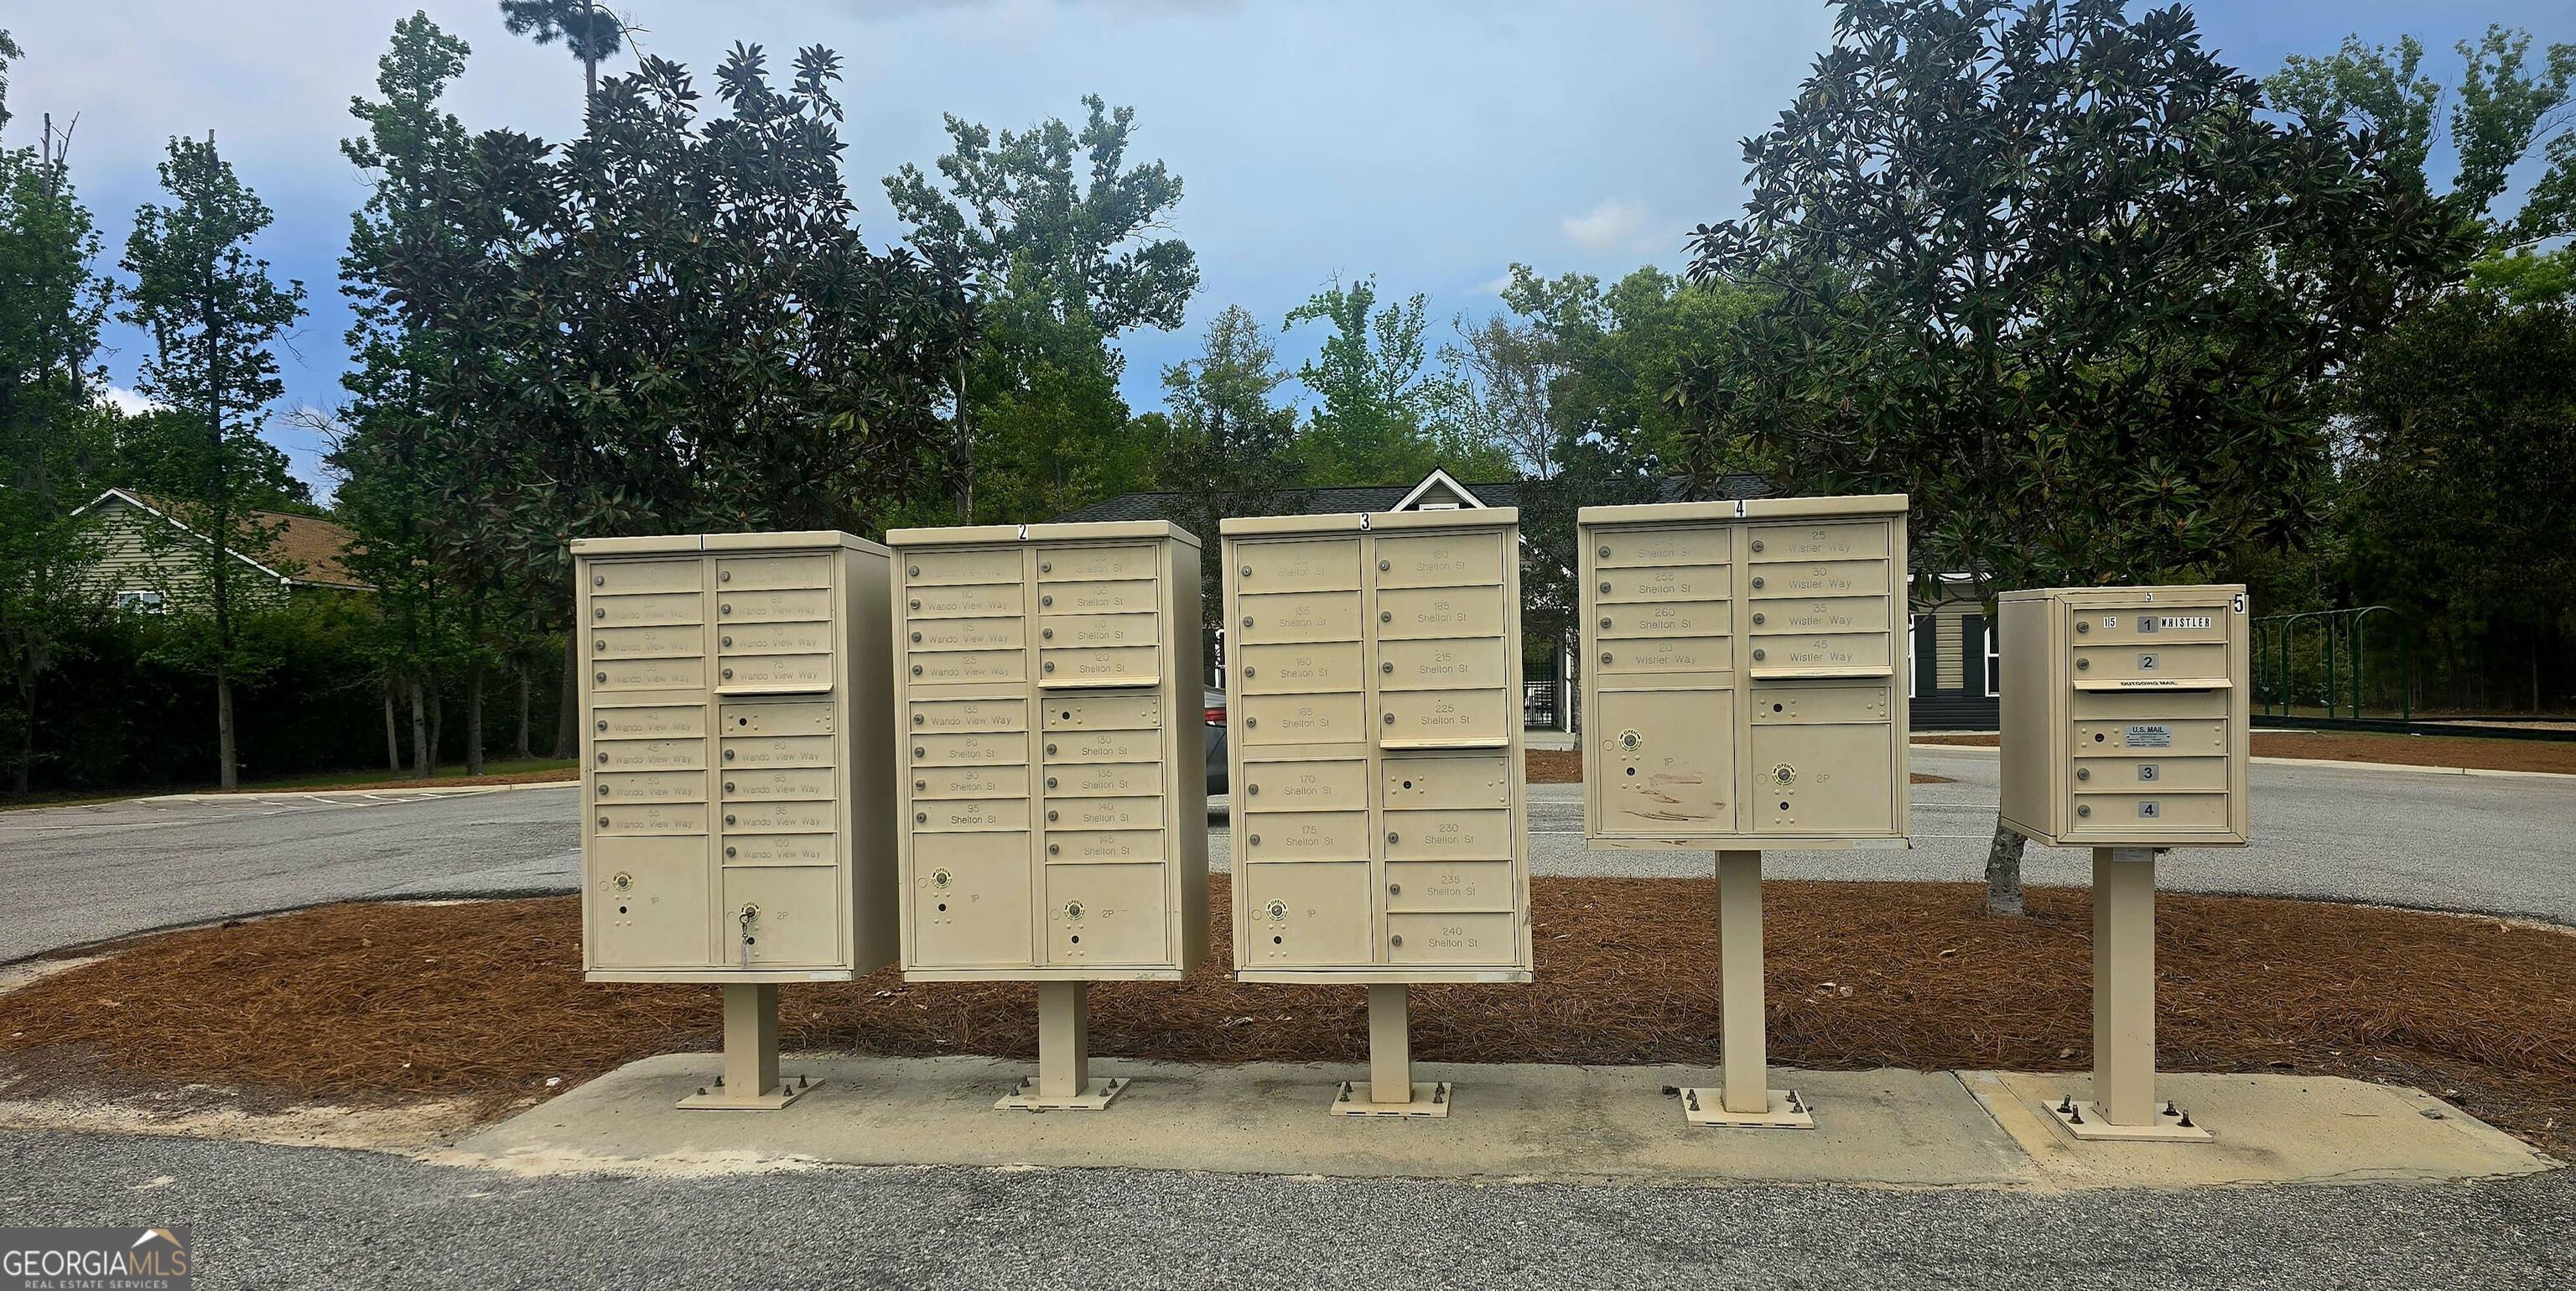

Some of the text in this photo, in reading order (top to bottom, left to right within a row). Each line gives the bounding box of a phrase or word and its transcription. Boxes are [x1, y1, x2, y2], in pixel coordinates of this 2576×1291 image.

[1736, 500, 1744, 517] 4
[1362, 514, 1369, 529] 3
[1019, 524, 1026, 539] 2
[1812, 531, 1826, 539] 25
[700, 534, 704, 549] 1
[1417, 561, 1465, 571] Shelton St
[1813, 567, 1826, 576] 30
[1789, 580, 1852, 589] Wistler Way
[1435, 602, 1449, 611] 185
[2235, 594, 2244, 612] 5
[1655, 608, 1675, 617] 260
[1814, 604, 1827, 612] 35
[1418, 613, 1467, 622] Shelton St
[1789, 616, 1852, 625] Wistler Way
[1640, 621, 1675, 629] Shelton
[2104, 618, 2210, 631] 15 1 WHISTLER
[1659, 643, 1673, 652] 20
[1814, 640, 1828, 649] 45
[1436, 653, 1451, 662] 215
[1830, 652, 1852, 662] Way
[772, 659, 784, 669] 75
[2144, 657, 2153, 668] 2
[1420, 665, 1452, 674] Shelton
[1436, 705, 1454, 713] 225
[992, 716, 1011, 726] Way
[1421, 716, 1454, 725] Shelton
[1665, 757, 1674, 766] 1P
[1098, 769, 1112, 778] 135
[2144, 768, 2153, 778] 3
[775, 774, 786, 783] 85
[1817, 774, 1830, 783] 2P
[1285, 786, 1332, 795] Shelton St
[2144, 804, 2153, 815] 4
[802, 817, 821, 825] Way
[775, 839, 789, 847] 100
[1100, 836, 1114, 844] 145
[1426, 836, 1458, 844] Shelton
[802, 850, 821, 859] Way
[1442, 876, 1460, 884] 235
[1427, 887, 1475, 896] Shelton St
[777, 911, 788, 919] 2P
[1103, 909, 1114, 918] 2P
[1308, 909, 1316, 918] 1P
[1443, 927, 1462, 935] 240
